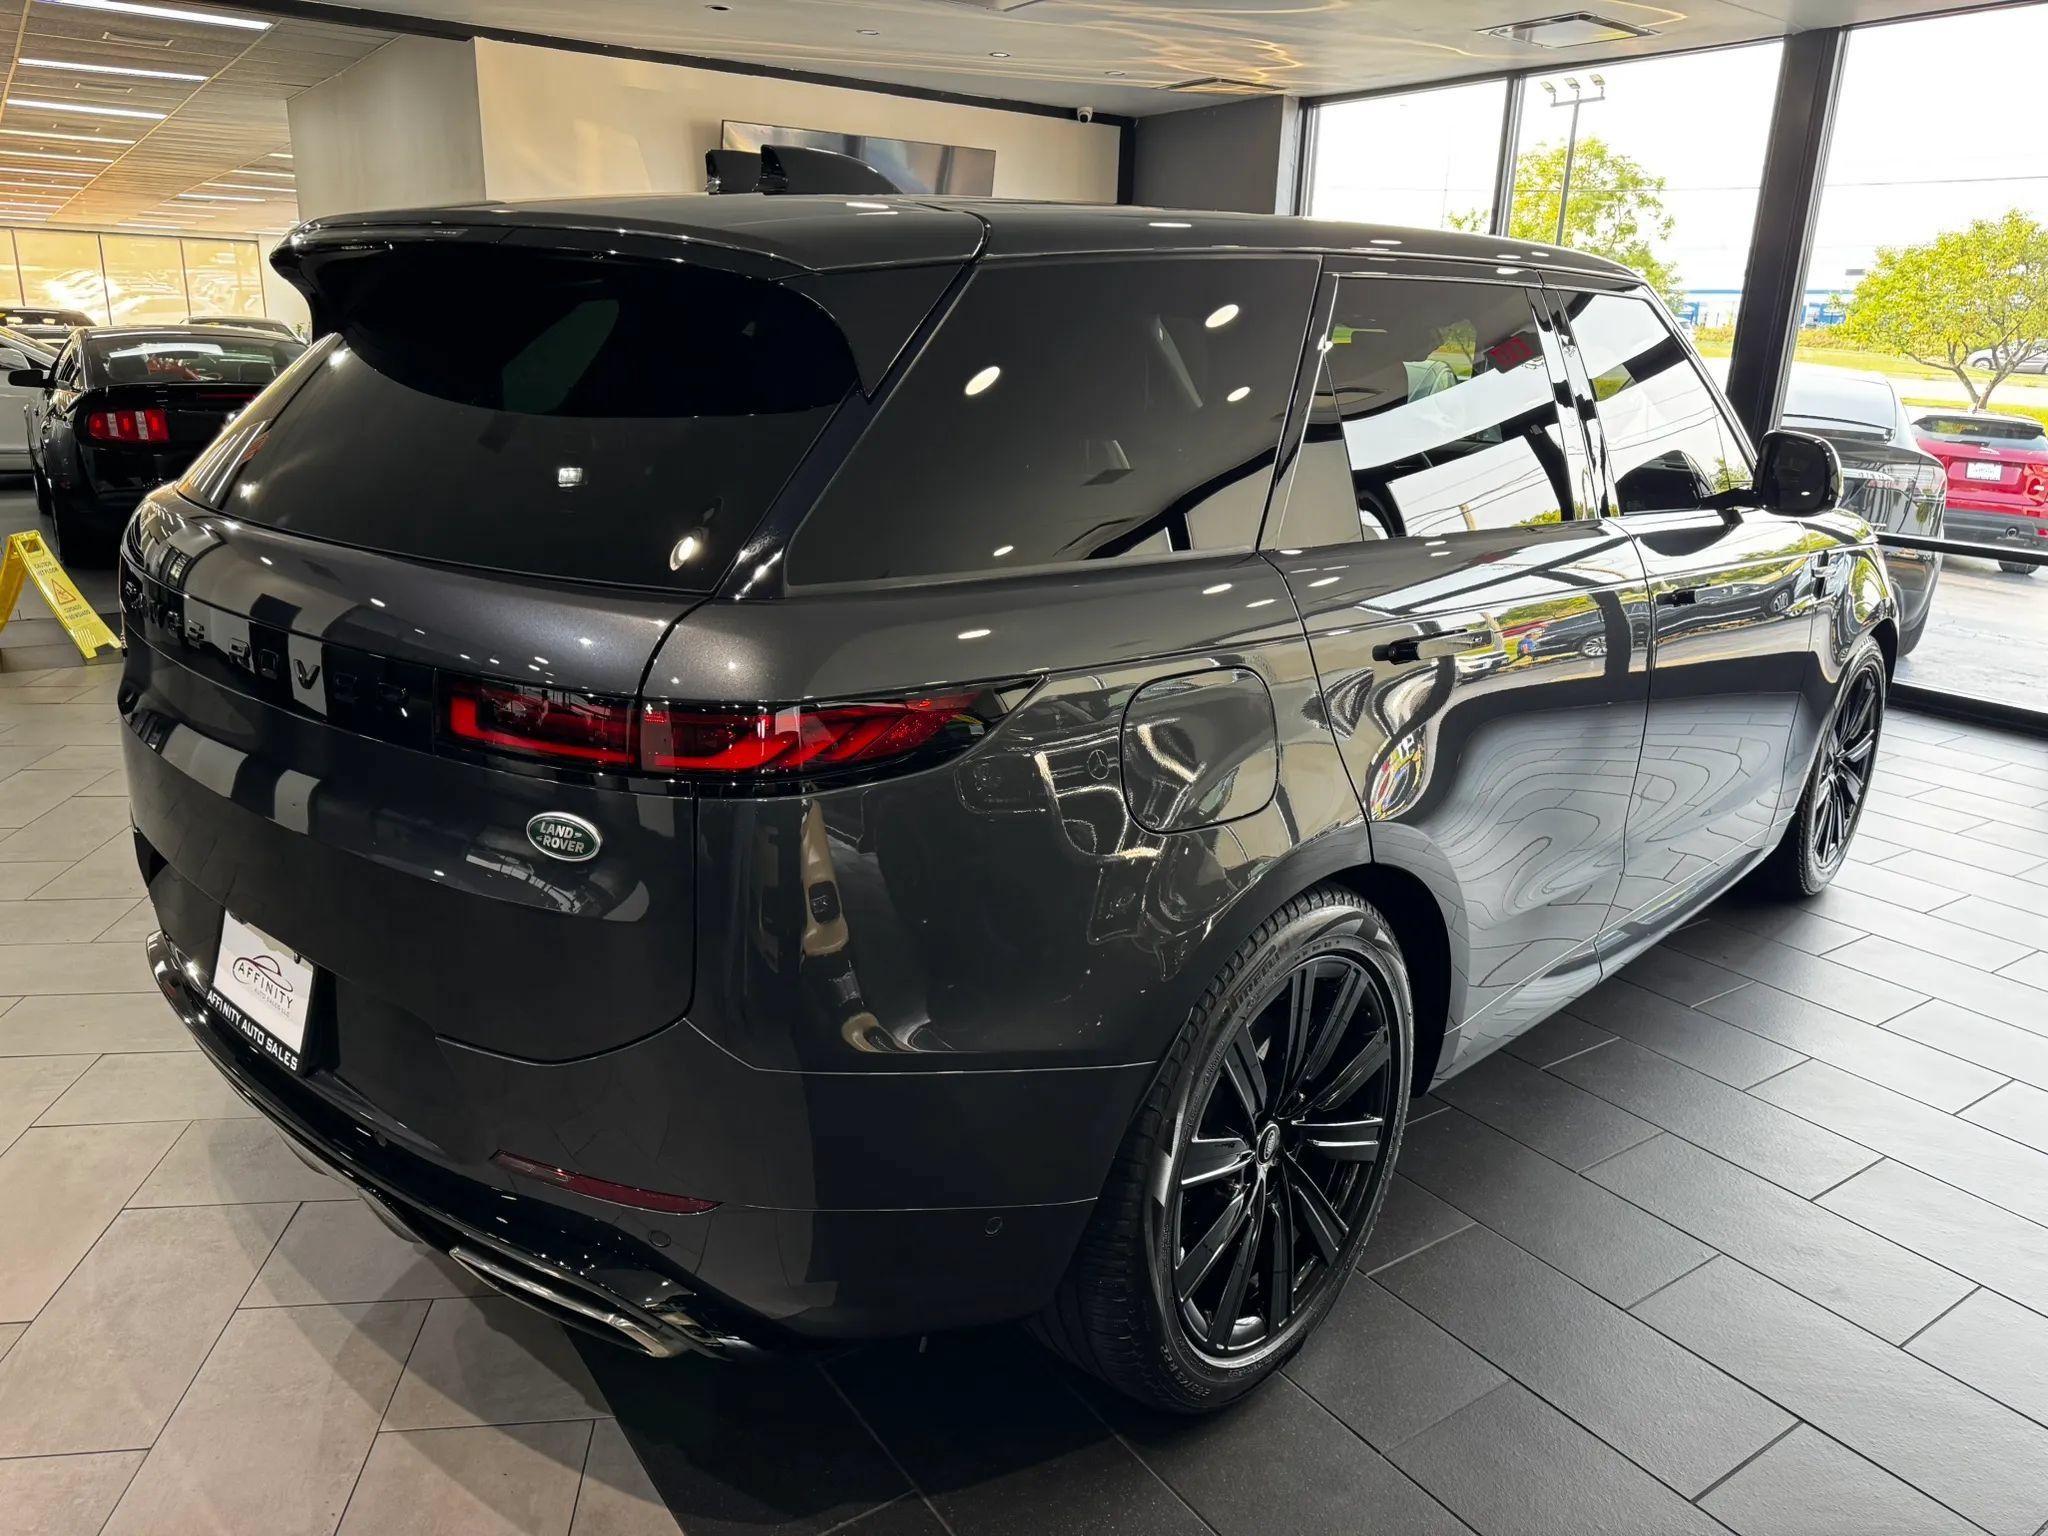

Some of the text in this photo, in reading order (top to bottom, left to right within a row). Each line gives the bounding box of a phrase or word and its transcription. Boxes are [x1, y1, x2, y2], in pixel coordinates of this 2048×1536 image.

[125, 581, 409, 709] RANGE ROVER
[540, 821, 574, 839] LAND
[542, 834, 585, 854] ROVER
[238, 962, 293, 1009] AFFINITY
[207, 990, 298, 1071] AFFINITY AUTO SALES
